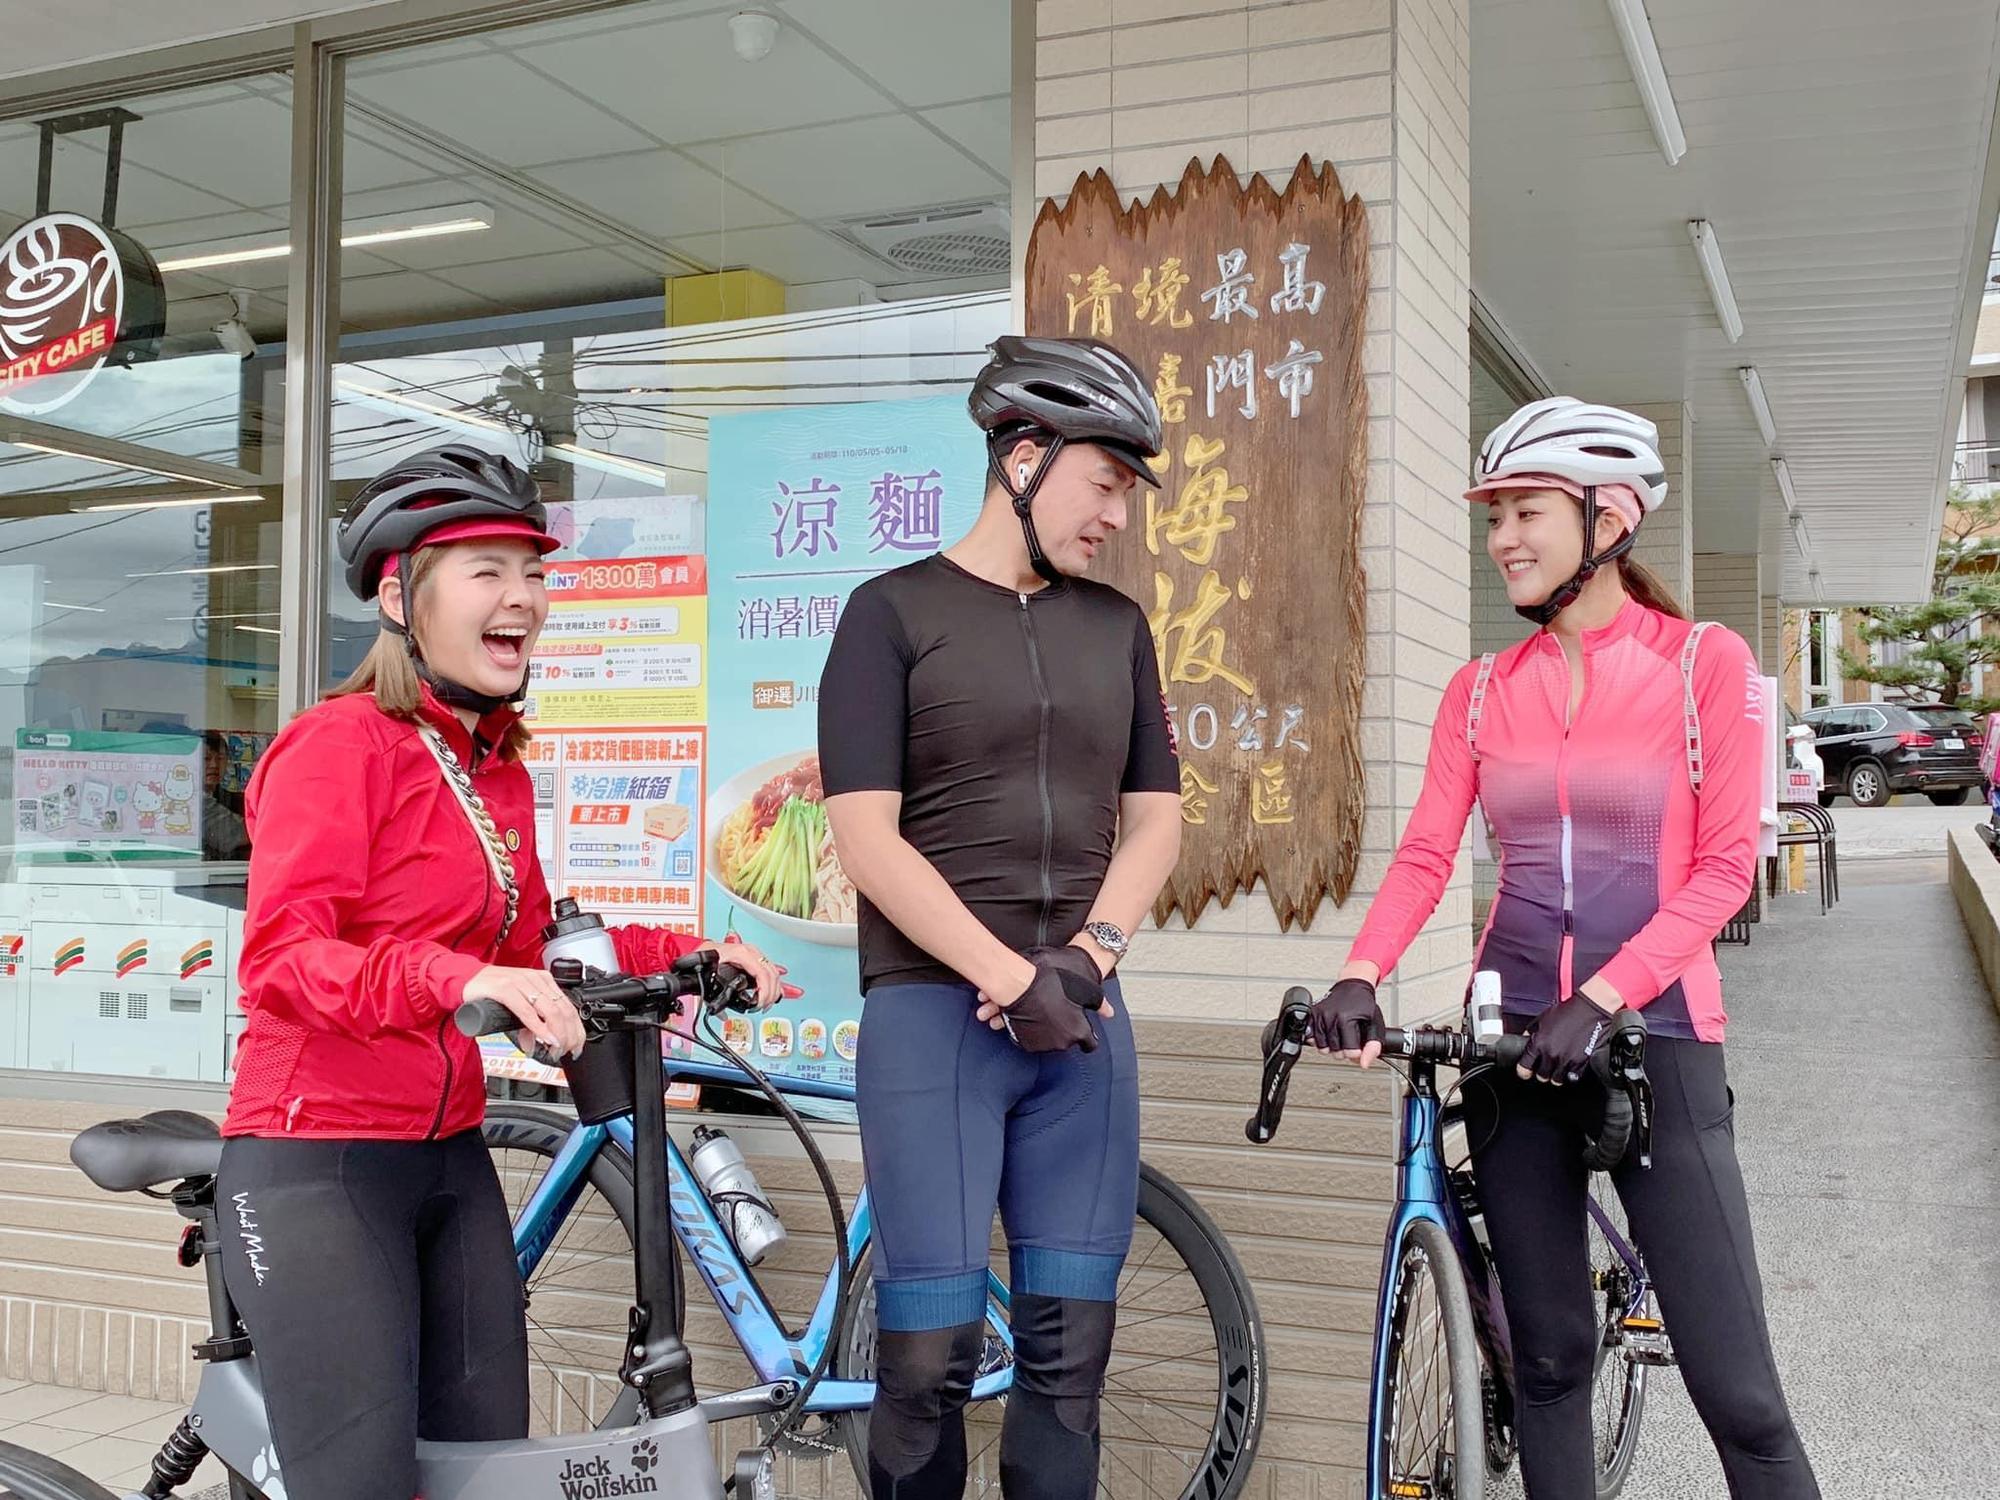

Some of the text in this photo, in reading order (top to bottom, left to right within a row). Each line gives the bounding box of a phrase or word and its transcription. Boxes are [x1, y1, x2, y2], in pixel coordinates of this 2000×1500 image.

[46, 324, 106, 368] CAFE
[771, 470, 943, 558] 涼麵
[738, 595, 839, 641] 消暑價
[755, 685, 793, 705] 御選
[23, 758, 56, 769] HELLO
[58, 759, 88, 770] KITTY
[586, 775, 672, 800] 冷凍紙箱
[579, 807, 623, 823] 新上市
[559, 1455, 612, 1481] Jack
[560, 1472, 658, 1500] Wolfskin
